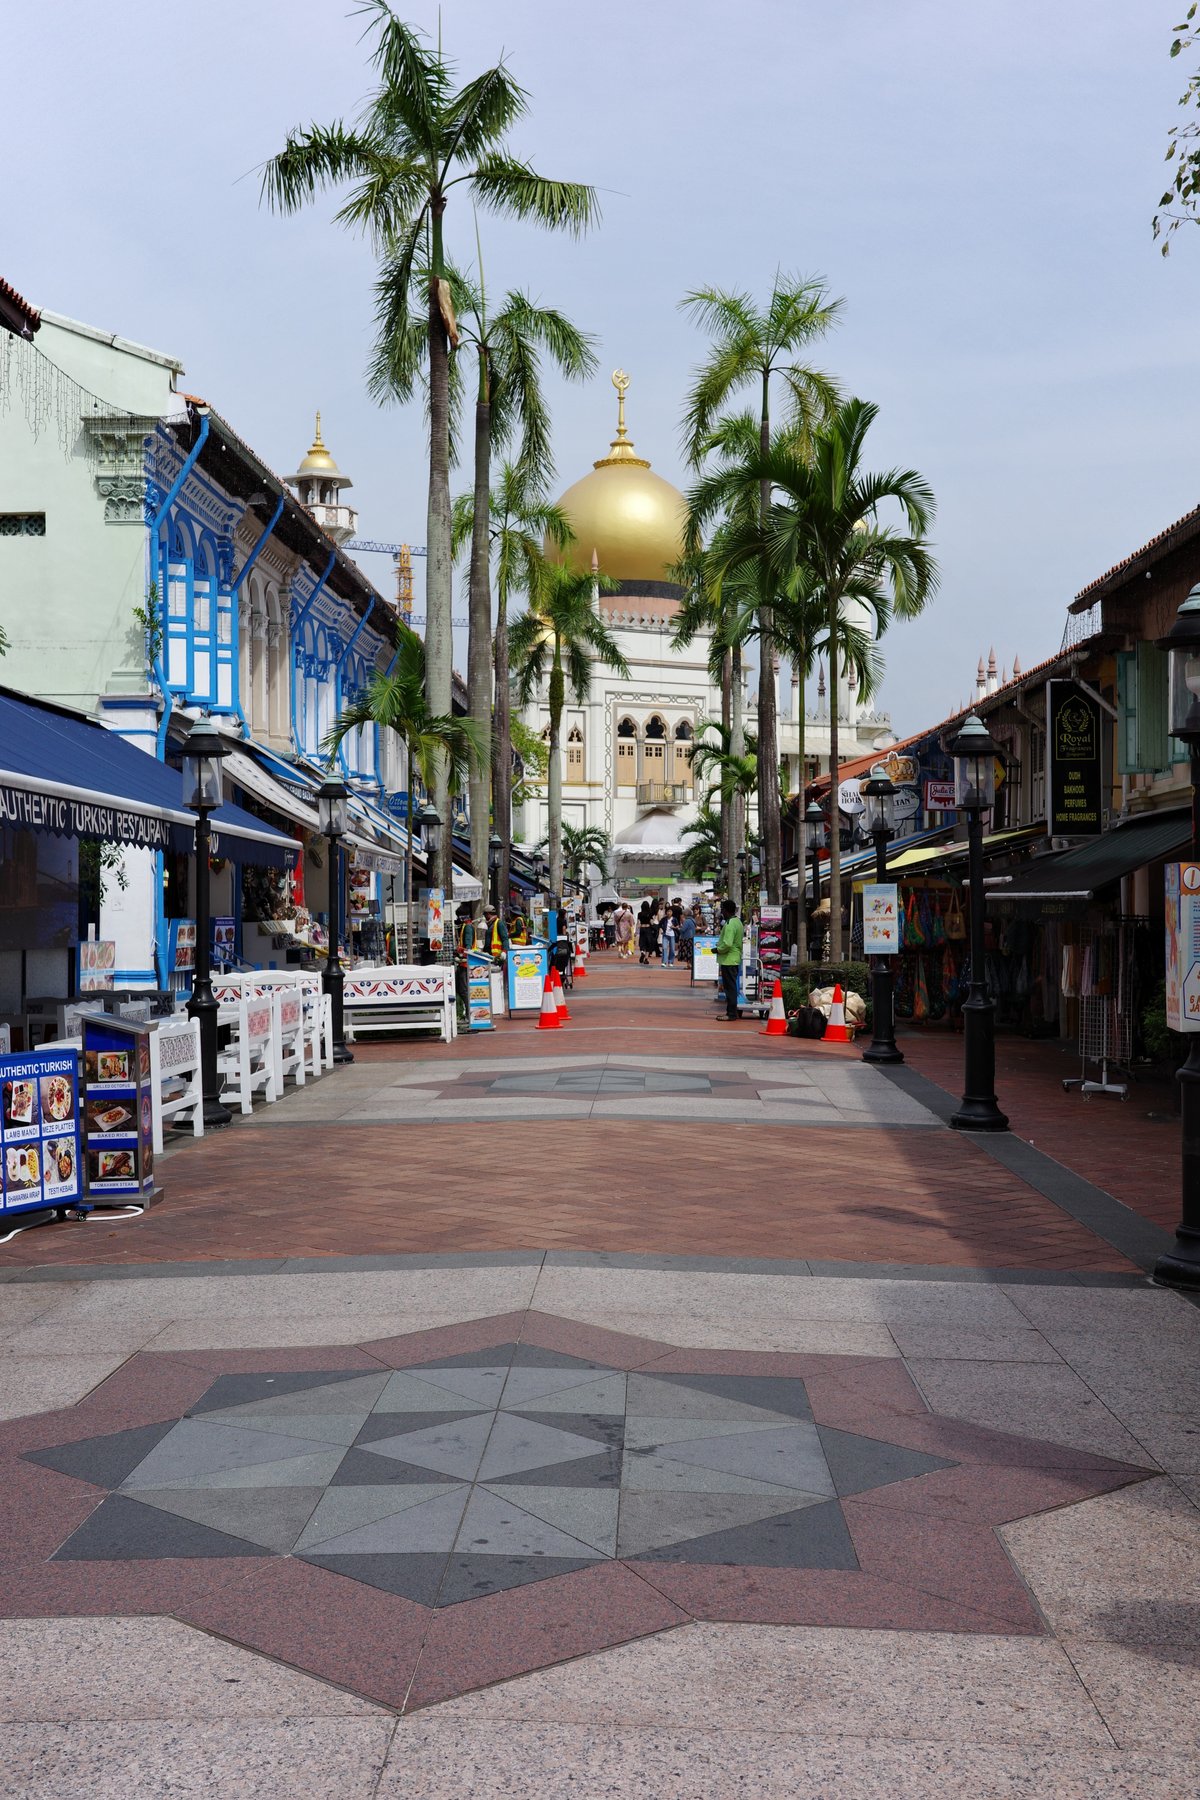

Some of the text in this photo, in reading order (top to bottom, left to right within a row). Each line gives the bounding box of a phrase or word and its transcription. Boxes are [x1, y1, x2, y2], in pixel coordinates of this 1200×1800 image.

[1059, 733, 1091, 746] Royal
[1063, 785, 1084, 794] BAKHOOR
[1064, 799, 1086, 807] PERFUMES
[70, 802, 114, 836] TURKISH
[116, 811, 171, 845] RESTAURANT
[1056, 812, 1097, 822] HOME FRAGRANCES
[0, 1060, 72, 1078] UTHENTIC TURKISH
[6, 1127, 38, 1140] LAMB MANDI
[43, 1121, 74, 1134] MEZE PLATTER
[59, 1185, 73, 1194] KEBAB
[8, 1194, 28, 1204] SHAWARMA
[28, 1191, 40, 1199] WRAP
